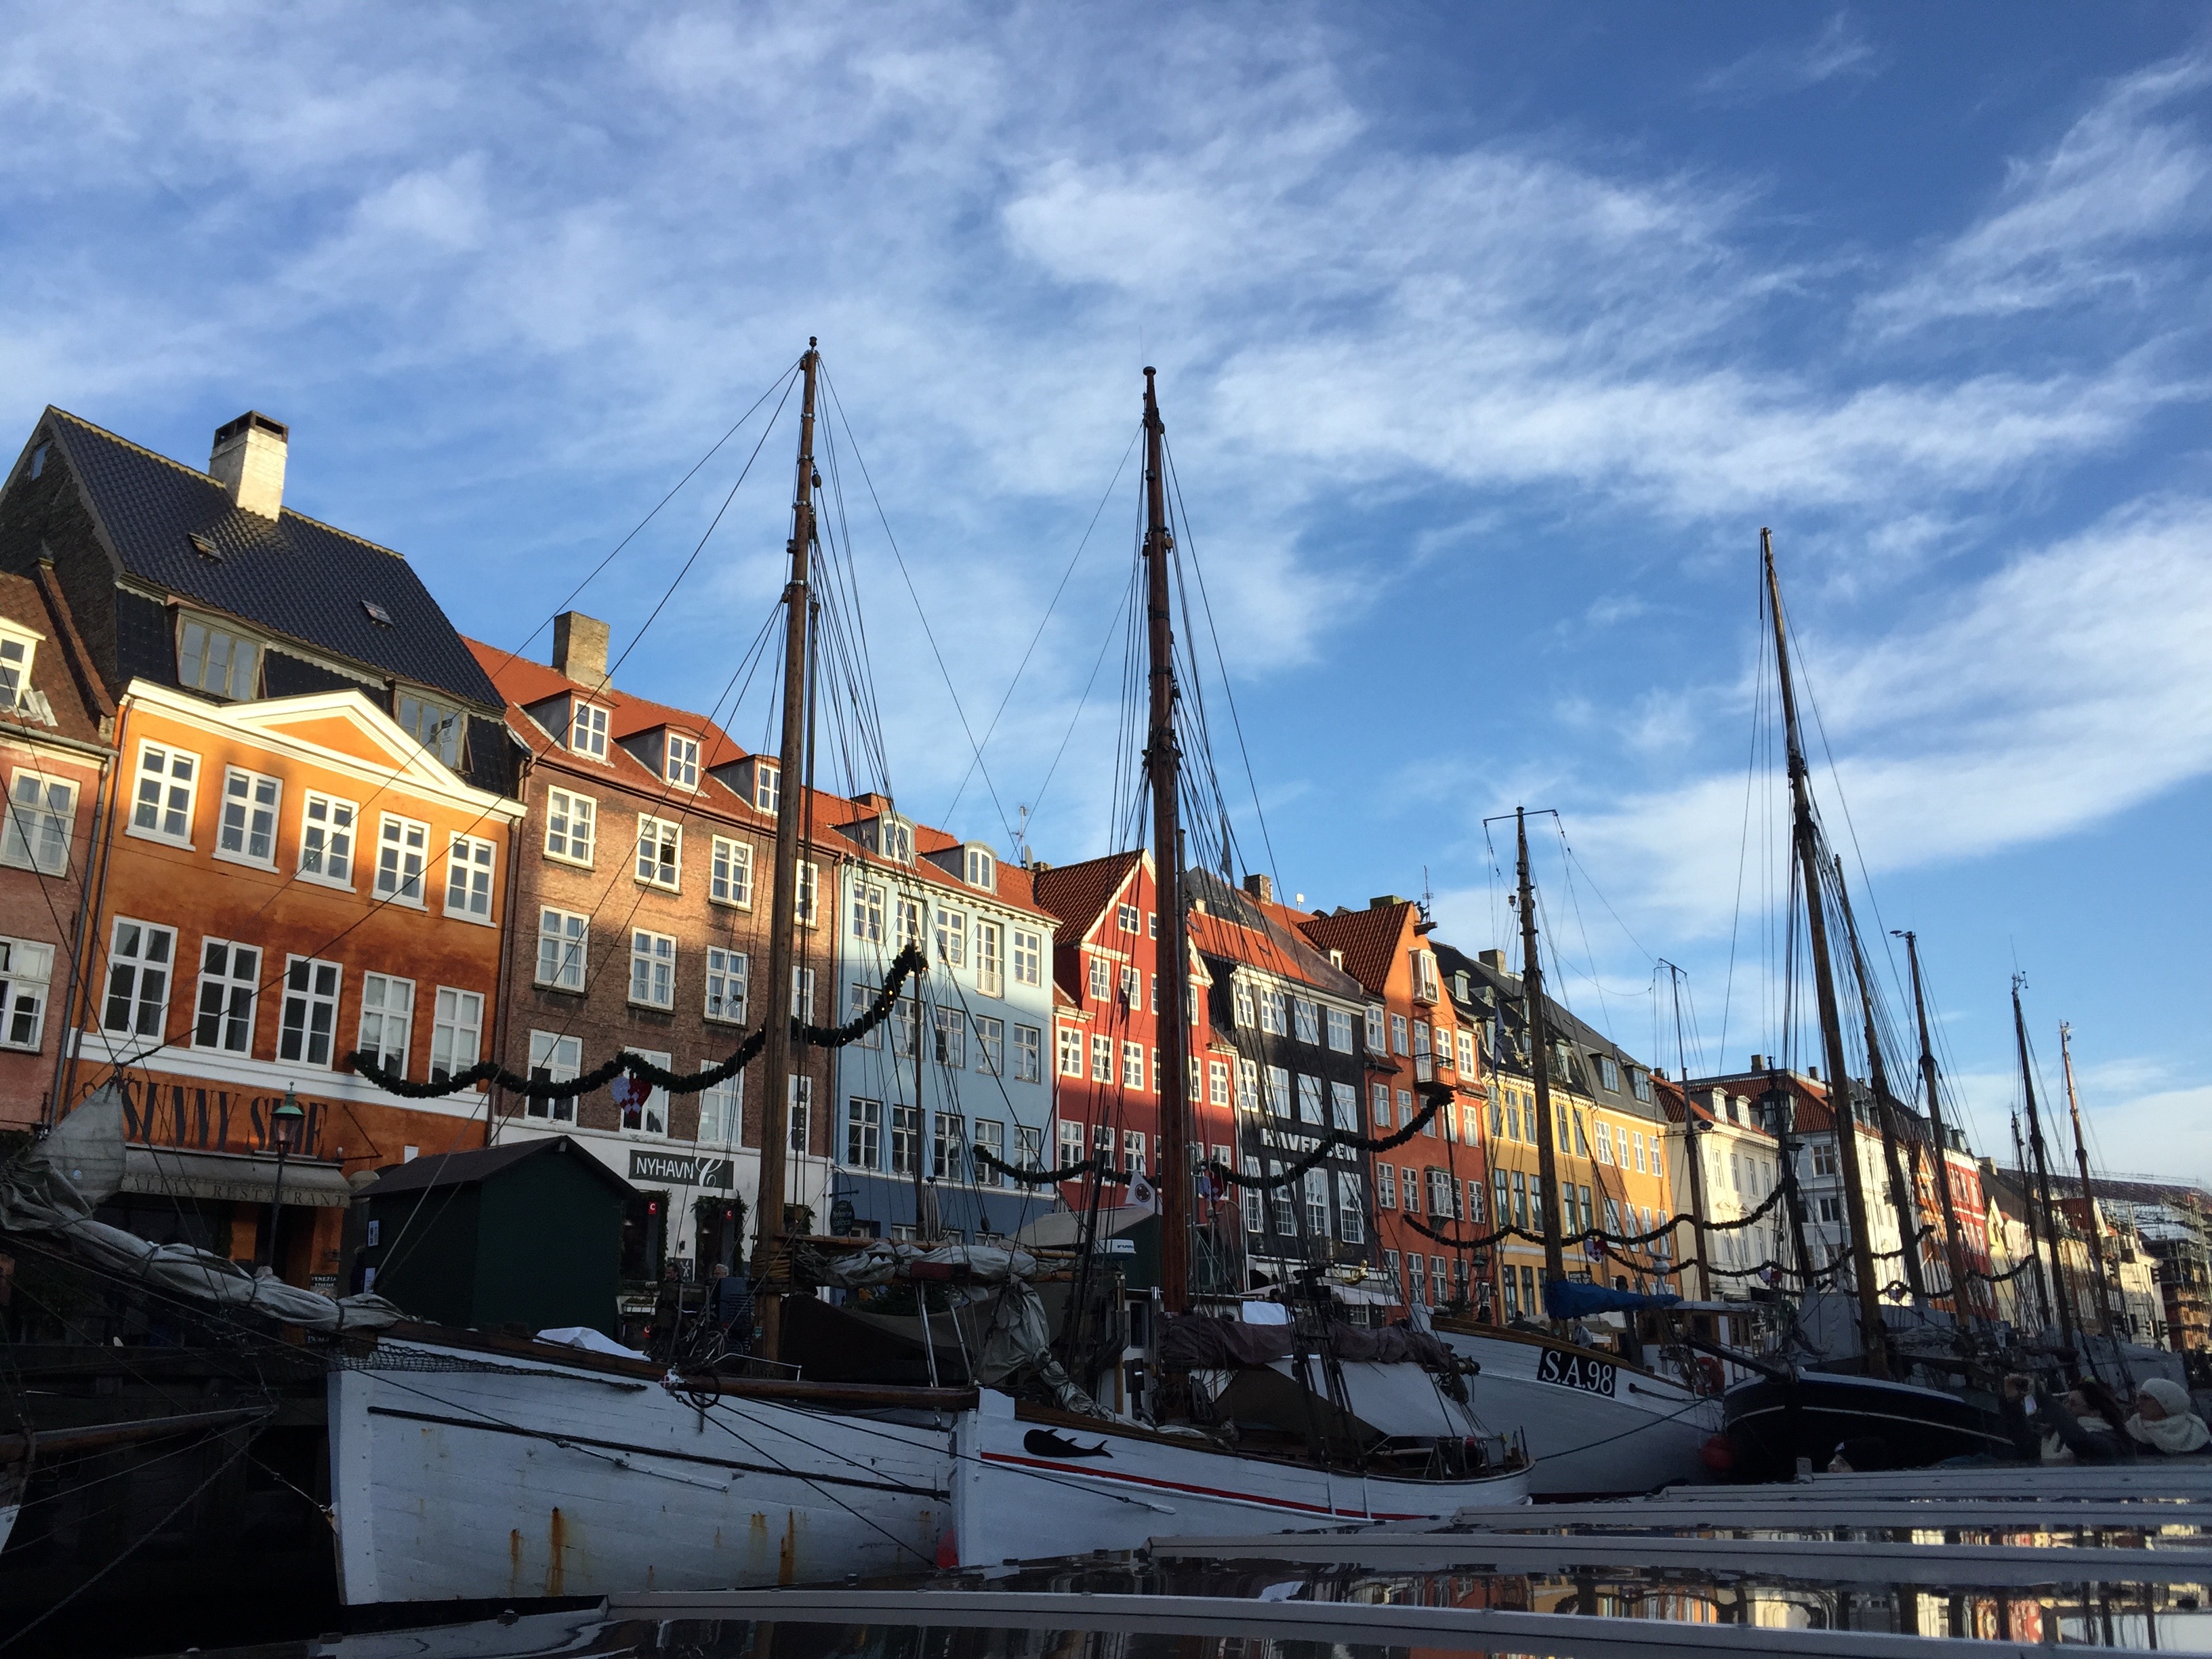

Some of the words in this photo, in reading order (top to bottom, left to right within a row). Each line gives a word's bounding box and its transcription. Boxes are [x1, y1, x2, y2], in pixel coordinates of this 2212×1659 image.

[121, 1080, 241, 1153] SUNNY
[250, 1096, 328, 1159] SIDE
[636, 1156, 694, 1180] NYHAVN
[212, 1185, 346, 1206] RESTAURANT
[649, 1203, 657, 1211] C
[1542, 1350, 1613, 1395] S.A.98
